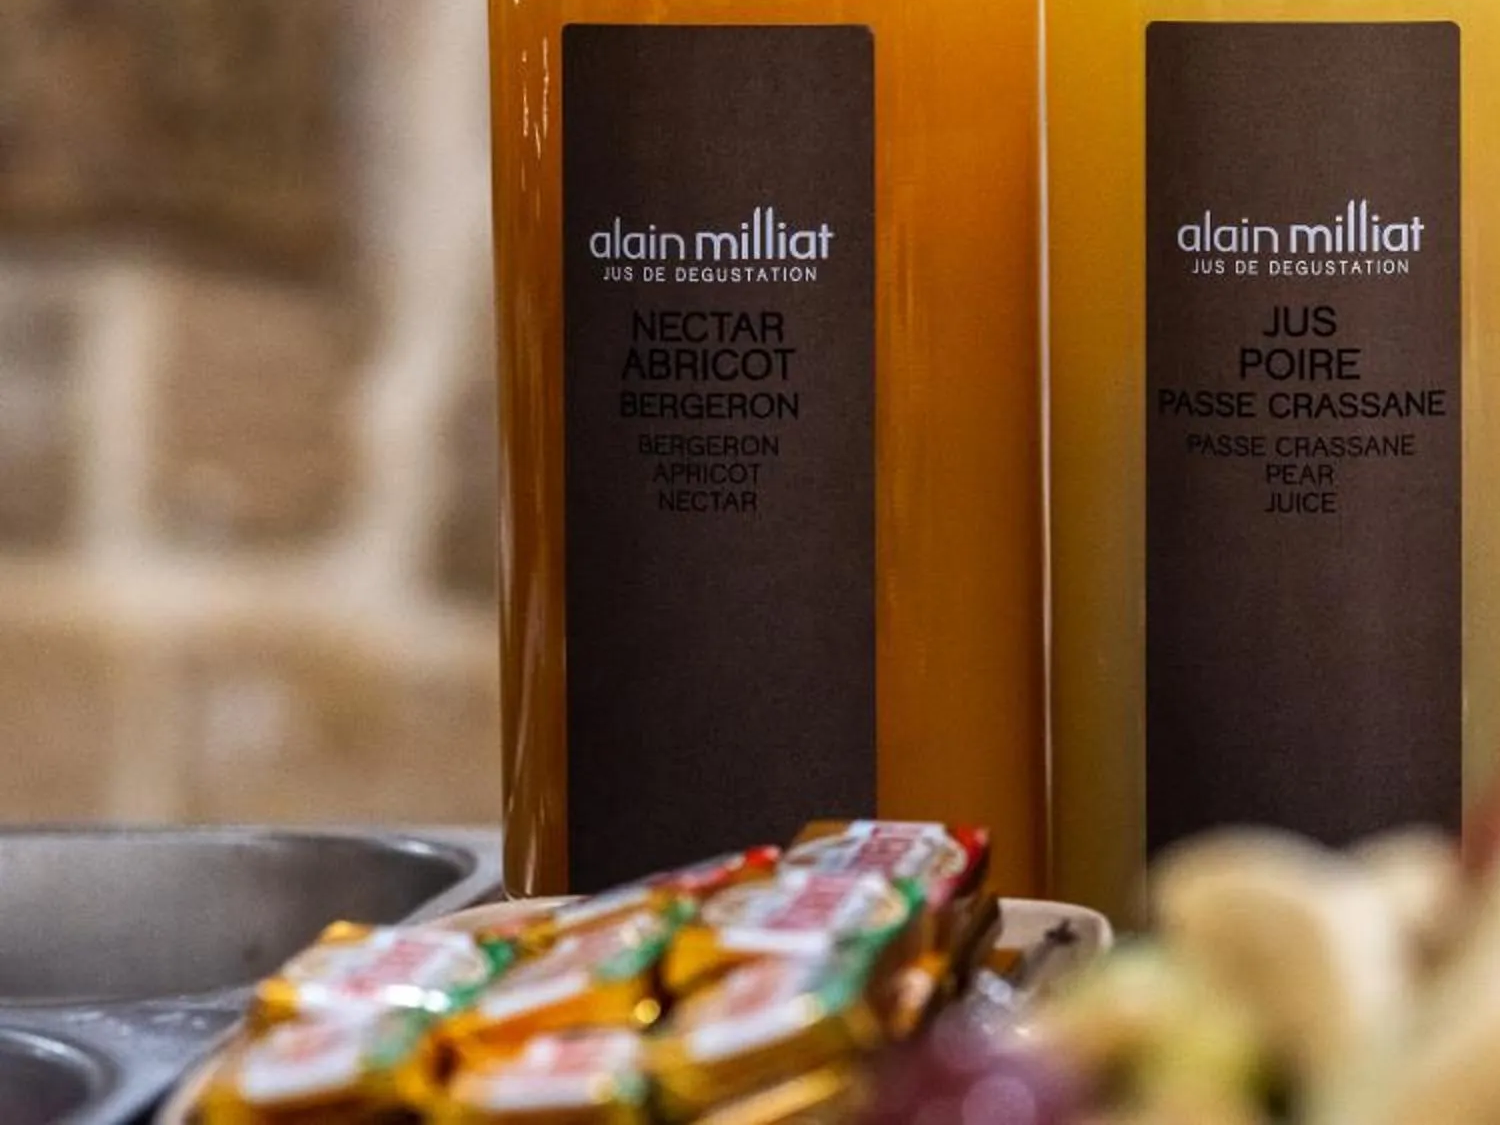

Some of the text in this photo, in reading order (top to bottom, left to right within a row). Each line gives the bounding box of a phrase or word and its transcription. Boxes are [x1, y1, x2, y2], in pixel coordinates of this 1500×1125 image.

[589, 206, 834, 260] alain milliat
[1177, 199, 1425, 253] alain milliat
[603, 266, 817, 282] JUS DE DEGUSTATION
[1192, 260, 1409, 275] JUS DE DEGUSTATION
[631, 310, 785, 343] NECTAR
[1263, 306, 1337, 338] JUS
[621, 348, 795, 381] ABRICOT
[1239, 348, 1360, 381] POIRE
[620, 392, 798, 420] BERGERON
[1159, 389, 1446, 419] PASSE CRASSANE
[639, 434, 779, 457] BERGERON
[1186, 433, 1415, 458] PASSE CRASSANE
[652, 464, 762, 484] APRICOT
[1265, 464, 1334, 486] PEAR
[659, 491, 757, 513] NECTAR
[1265, 492, 1336, 514] JUICE
